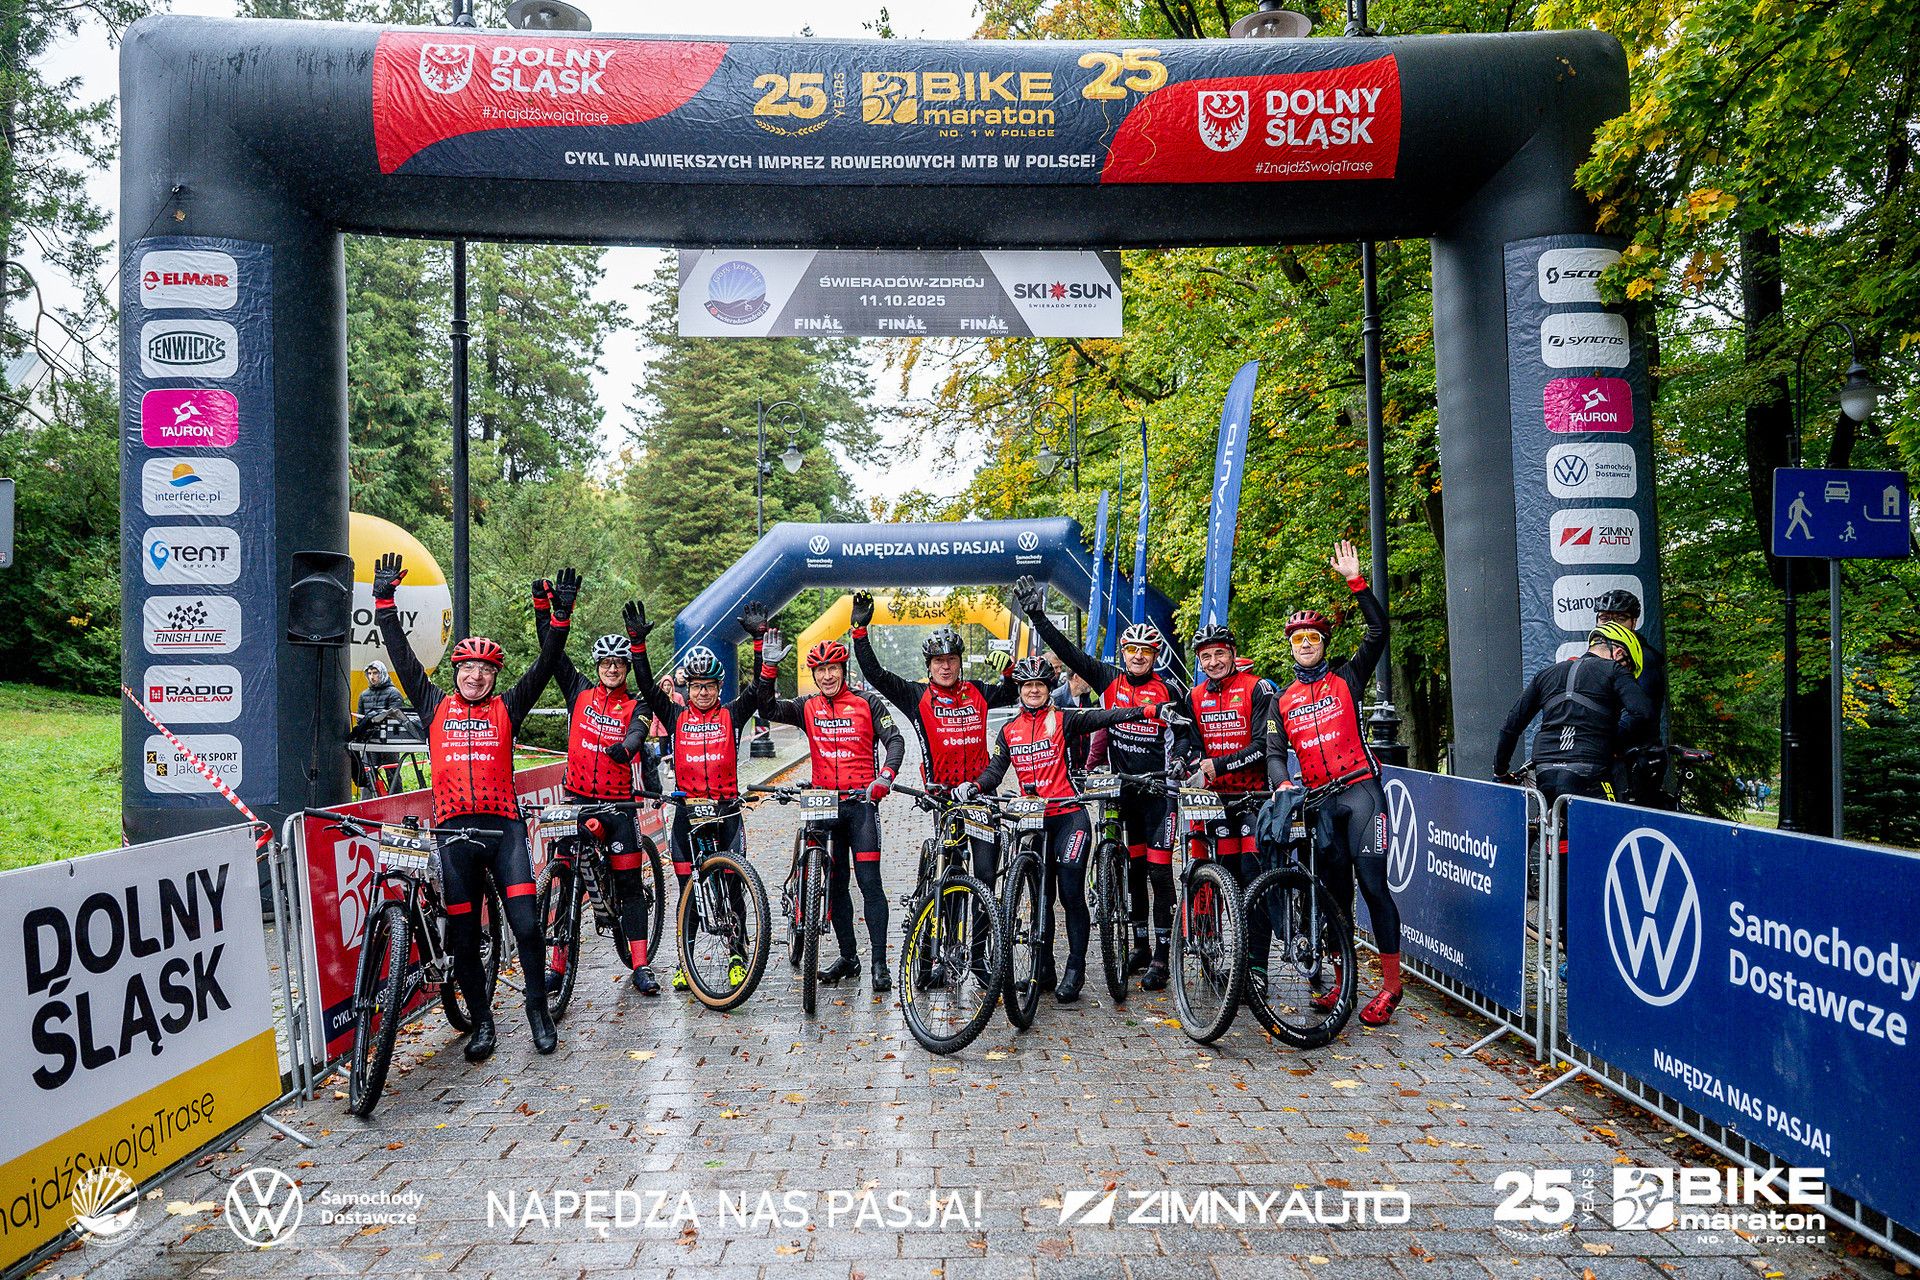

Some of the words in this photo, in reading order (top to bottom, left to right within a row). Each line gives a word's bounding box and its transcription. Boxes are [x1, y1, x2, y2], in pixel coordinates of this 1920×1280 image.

[491, 46, 617, 69] DOLNY
[1078, 48, 1168, 100] 25
[490, 66, 605, 98] ŚLĄSK
[923, 71, 1055, 101] BIKE
[753, 73, 827, 119] 25
[833, 72, 845, 118] YEARS
[1266, 88, 1383, 116] DOLNY
[482, 106, 609, 124] #ZnajdźSwojąTrasę
[923, 108, 1056, 126] maraton
[939, 129, 964, 138] NO.
[970, 129, 978, 138] 1
[984, 129, 997, 138] W
[1001, 128, 1056, 138] POLSCE
[1265, 112, 1374, 149] ŚLĄSK
[564, 151, 610, 167] CYKL
[615, 152, 752, 170] NAJWIĘKSZYCH
[758, 155, 826, 169] IMPREZ
[830, 154, 955, 169] ROWEROWYCH
[961, 154, 998, 169] MTB
[1004, 154, 1024, 168] W
[1026, 153, 1097, 169] POLSCE!
[1255, 160, 1374, 175] #ZnajdźSwojąTrasę
[163, 272, 230, 287] ELMAR
[819, 274, 985, 288] ŚWIERADÓW-ZDRÓJ
[1014, 283, 1047, 299] SKI
[1069, 283, 1112, 299] SUN
[860, 294, 946, 307] 11.10.2025
[794, 317, 843, 330] FINAŁ
[878, 317, 927, 330] FINAŁ
[960, 317, 1009, 330] FINAŁ
[148, 335, 227, 360] FENWICK'S
[1569, 412, 1617, 422] TAURON
[160, 426, 214, 437] TAURON
[1595, 463, 1632, 472] Samochody
[155, 491, 221, 503] interferie.pl
[1599, 527, 1634, 536] ZIMNY
[1598, 536, 1631, 546] AUTO
[842, 542, 915, 559] NAPĘDZA
[917, 542, 949, 556] NAS
[953, 540, 1005, 555] PASJA!
[1061, 616, 1067, 629] 1
[155, 632, 192, 643] FINISH
[194, 632, 223, 643] LINE
[165, 686, 233, 695] RADIO
[1290, 696, 1331, 717] LINCOLN
[1299, 703, 1337, 722] ELECTRIC
[815, 718, 850, 727] LINCOLN
[947, 715, 979, 724] ELECTRIC
[1201, 711, 1236, 722] LINCOLN
[445, 720, 488, 731] LINCOLN
[683, 723, 719, 733] LINCOLN
[1119, 724, 1155, 733] ELECTRIC
[1209, 721, 1241, 730] ELECTRIC
[1301, 731, 1337, 750] bester
[1010, 741, 1048, 756] LINCOLN
[209, 752, 238, 761] SPORT
[1017, 749, 1055, 763] ELECTRIC
[174, 763, 238, 776] Jakuzyce
[1092, 779, 1115, 788] 544
[807, 797, 832, 807] 582
[1014, 800, 1039, 812] 586
[1185, 794, 1218, 805] 1407
[547, 810, 572, 820] 443
[968, 810, 989, 824] 588
[390, 835, 422, 849] 775
[1427, 820, 1498, 868] Samochody
[1427, 851, 1493, 895] Dostawcze
[22, 862, 230, 997] DOLNY
[1424, 934, 1440, 956] NAS
[1439, 941, 1466, 966] PASJA!
[1729, 901, 1920, 1001] Samochody
[1729, 948, 1908, 1046] Dostawcze
[31, 942, 232, 1091] ŚLĄSK
[1654, 1048, 1725, 1104] NAPĘDZA
[1727, 1084, 1763, 1122] NAS
[1767, 1104, 1832, 1158] PASJA!
